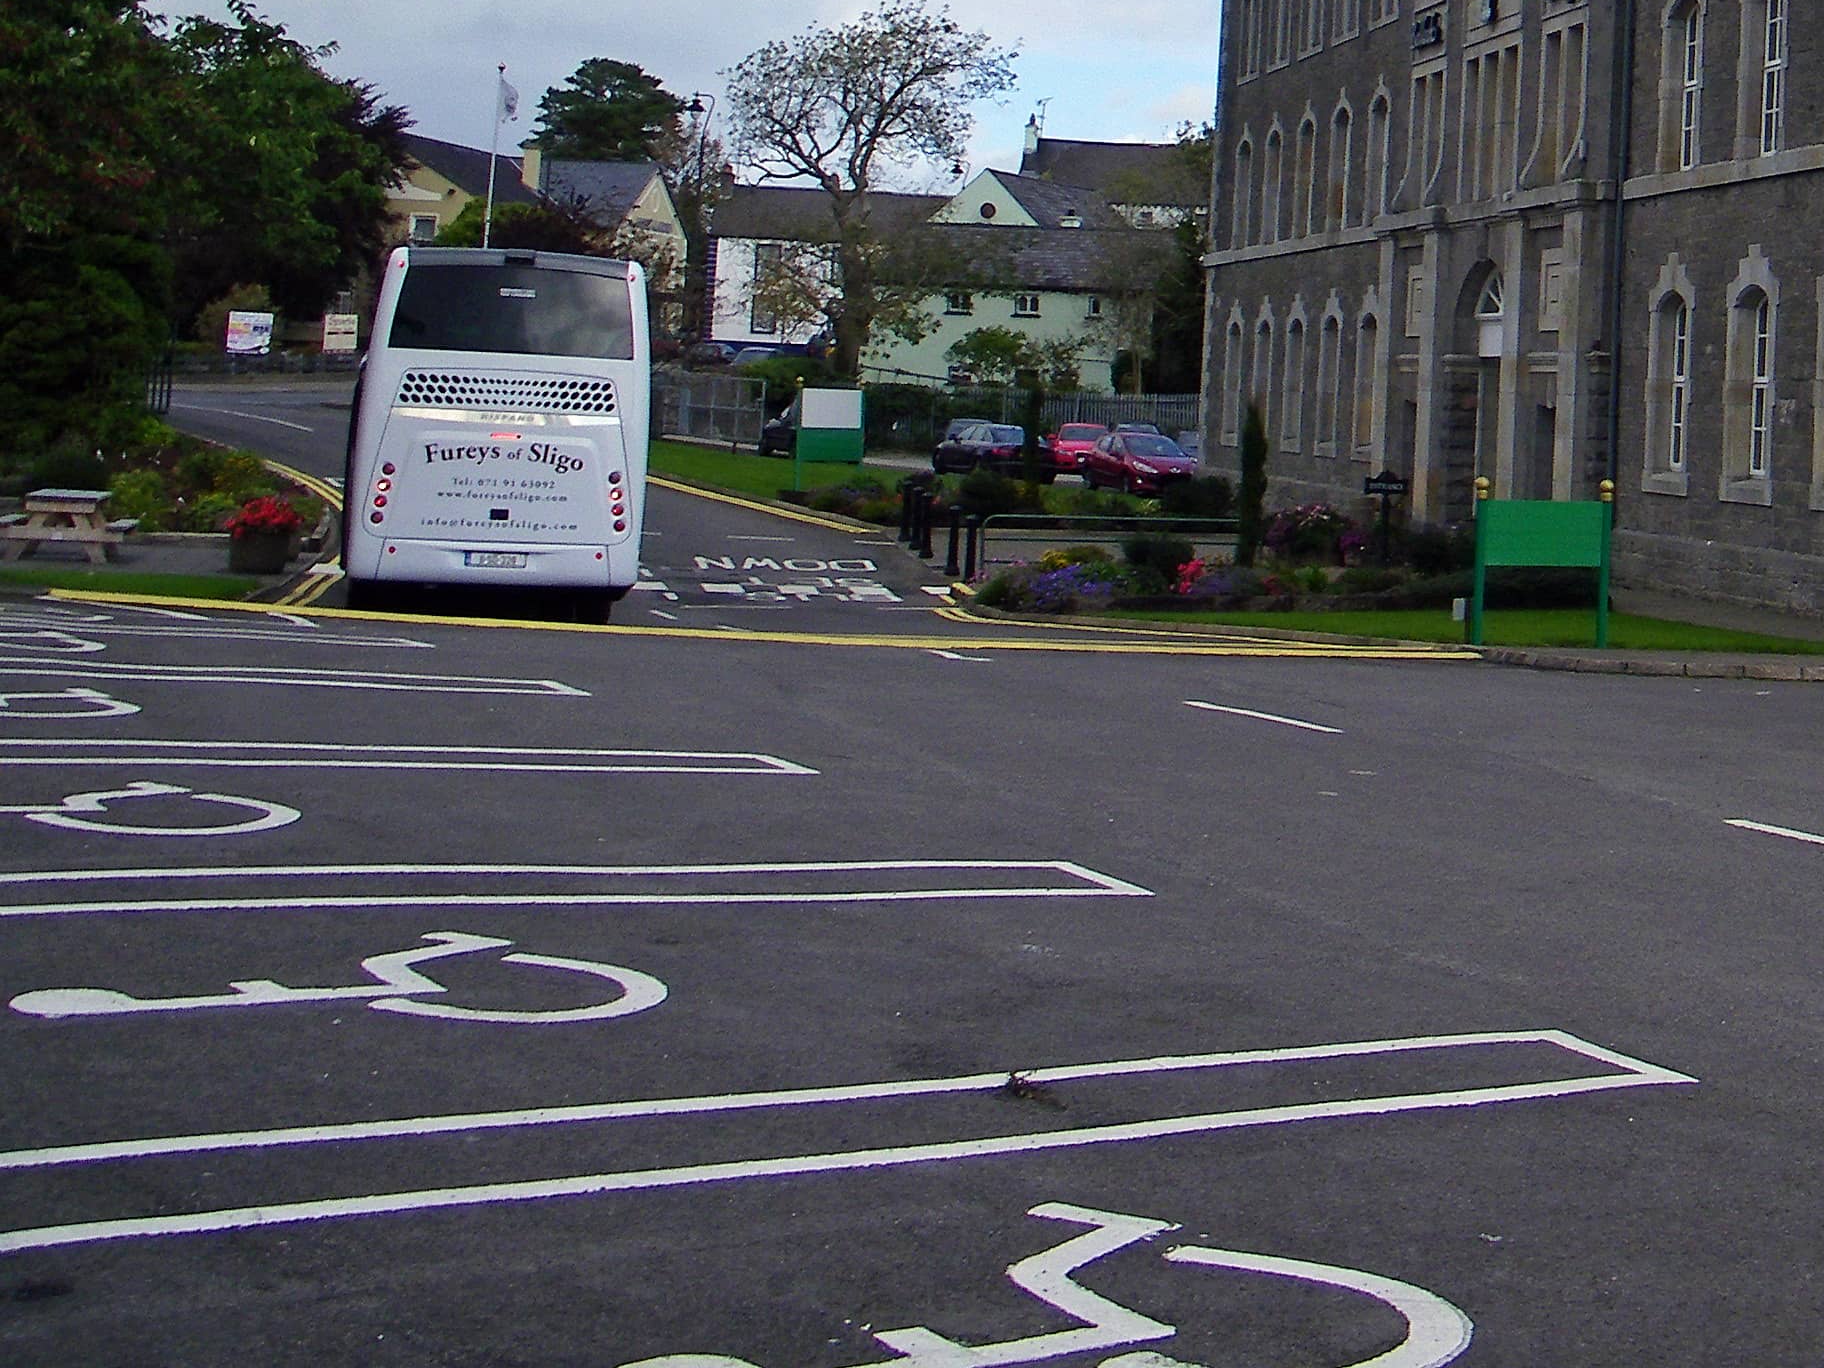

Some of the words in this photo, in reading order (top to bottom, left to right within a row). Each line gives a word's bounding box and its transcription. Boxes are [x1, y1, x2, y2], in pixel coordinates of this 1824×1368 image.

[424, 442, 501, 465] Fureys
[506, 448, 524, 461] of
[527, 442, 584, 474] Sligo
[693, 554, 879, 572] DOWN
